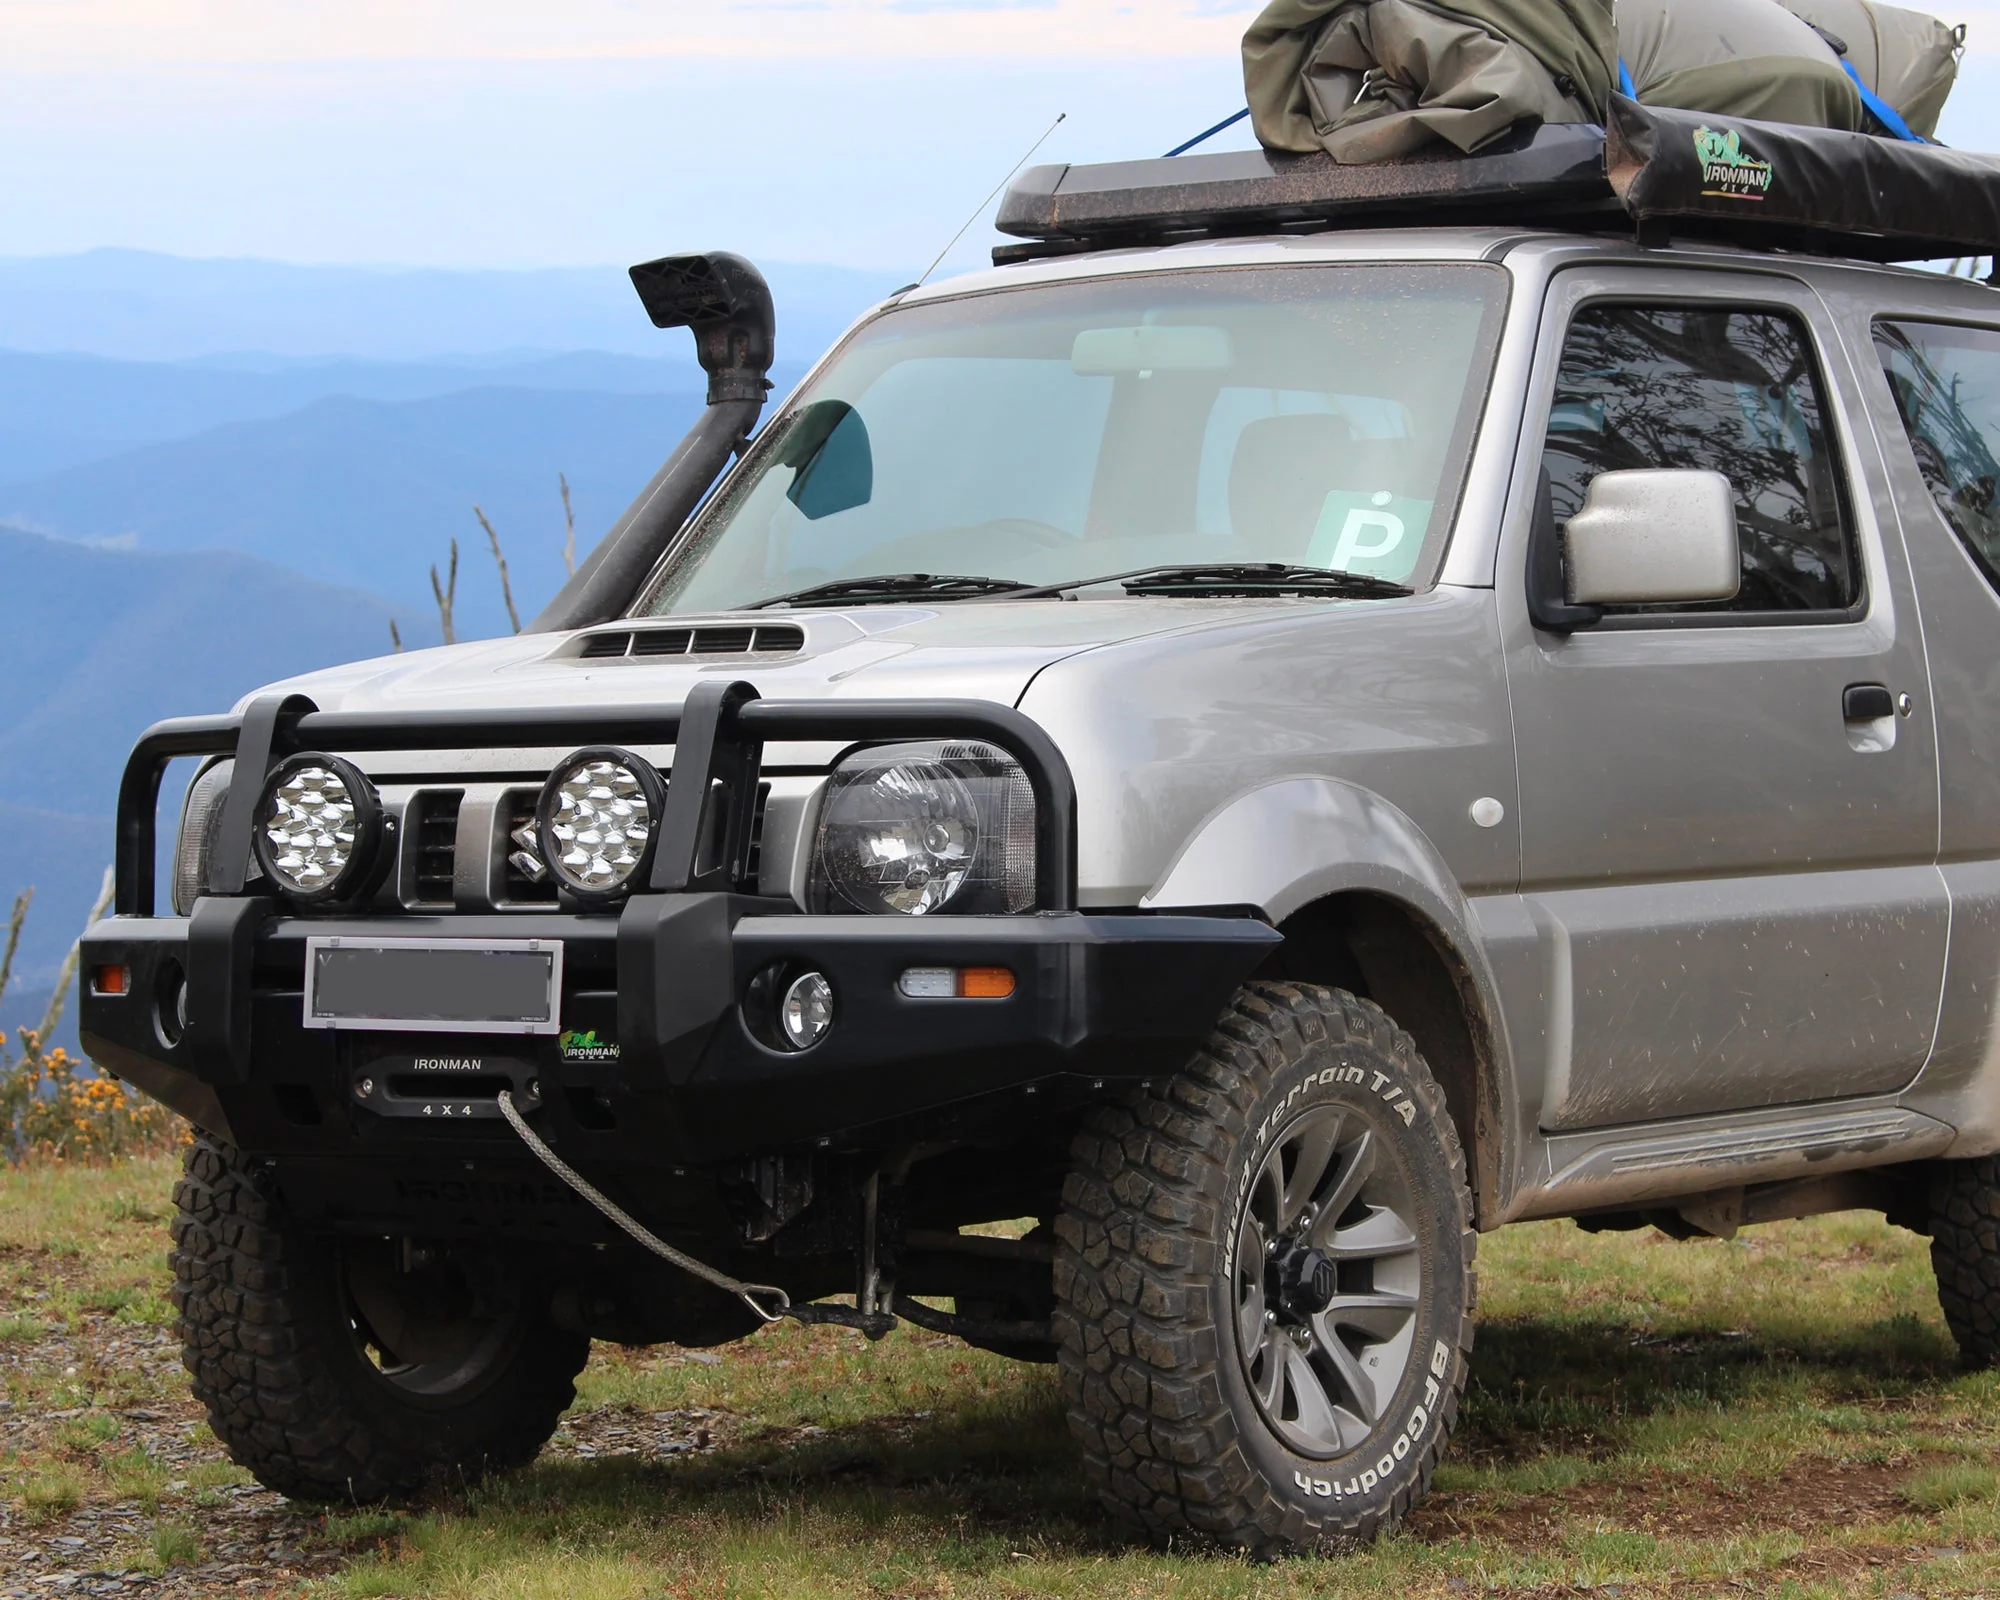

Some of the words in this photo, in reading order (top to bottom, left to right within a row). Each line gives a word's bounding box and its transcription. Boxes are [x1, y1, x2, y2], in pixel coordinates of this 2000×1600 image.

[1705, 165, 1767, 186] IRONMAN
[1329, 508, 1405, 572] P
[567, 1047, 617, 1056] IRONMAN
[413, 1058, 482, 1071] IRONMAN
[1294, 1339, 1450, 1501] BFGoodrich
